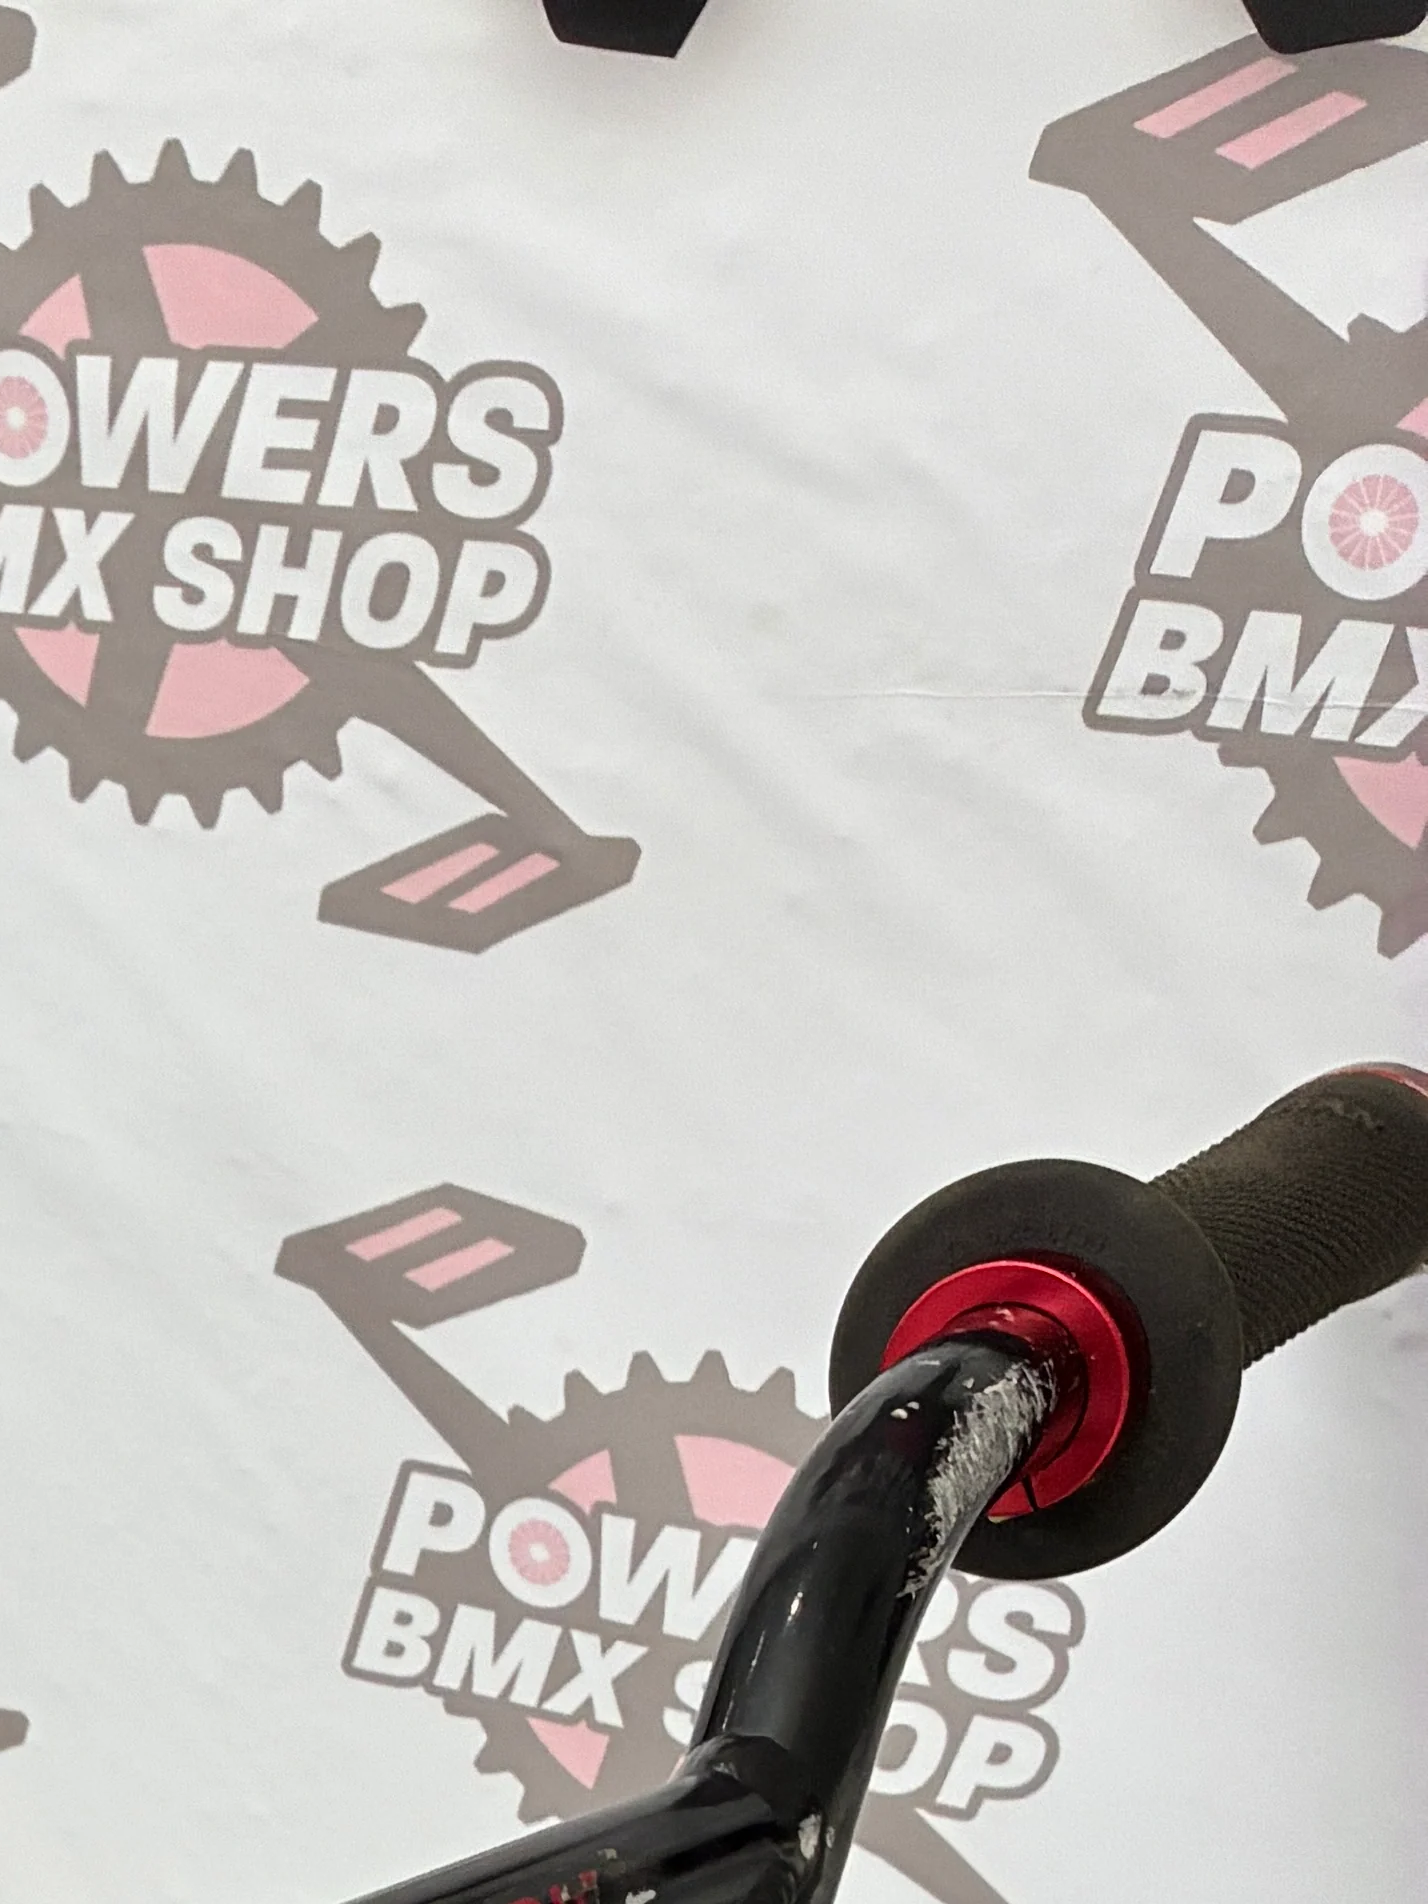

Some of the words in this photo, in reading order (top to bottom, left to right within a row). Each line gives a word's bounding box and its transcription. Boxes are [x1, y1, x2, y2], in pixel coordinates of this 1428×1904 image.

[151, 515, 542, 657] SHOP
[353, 1585, 647, 1729] BMX
[663, 1659, 1047, 1808] OP
[381, 1471, 1073, 1703] POWS
